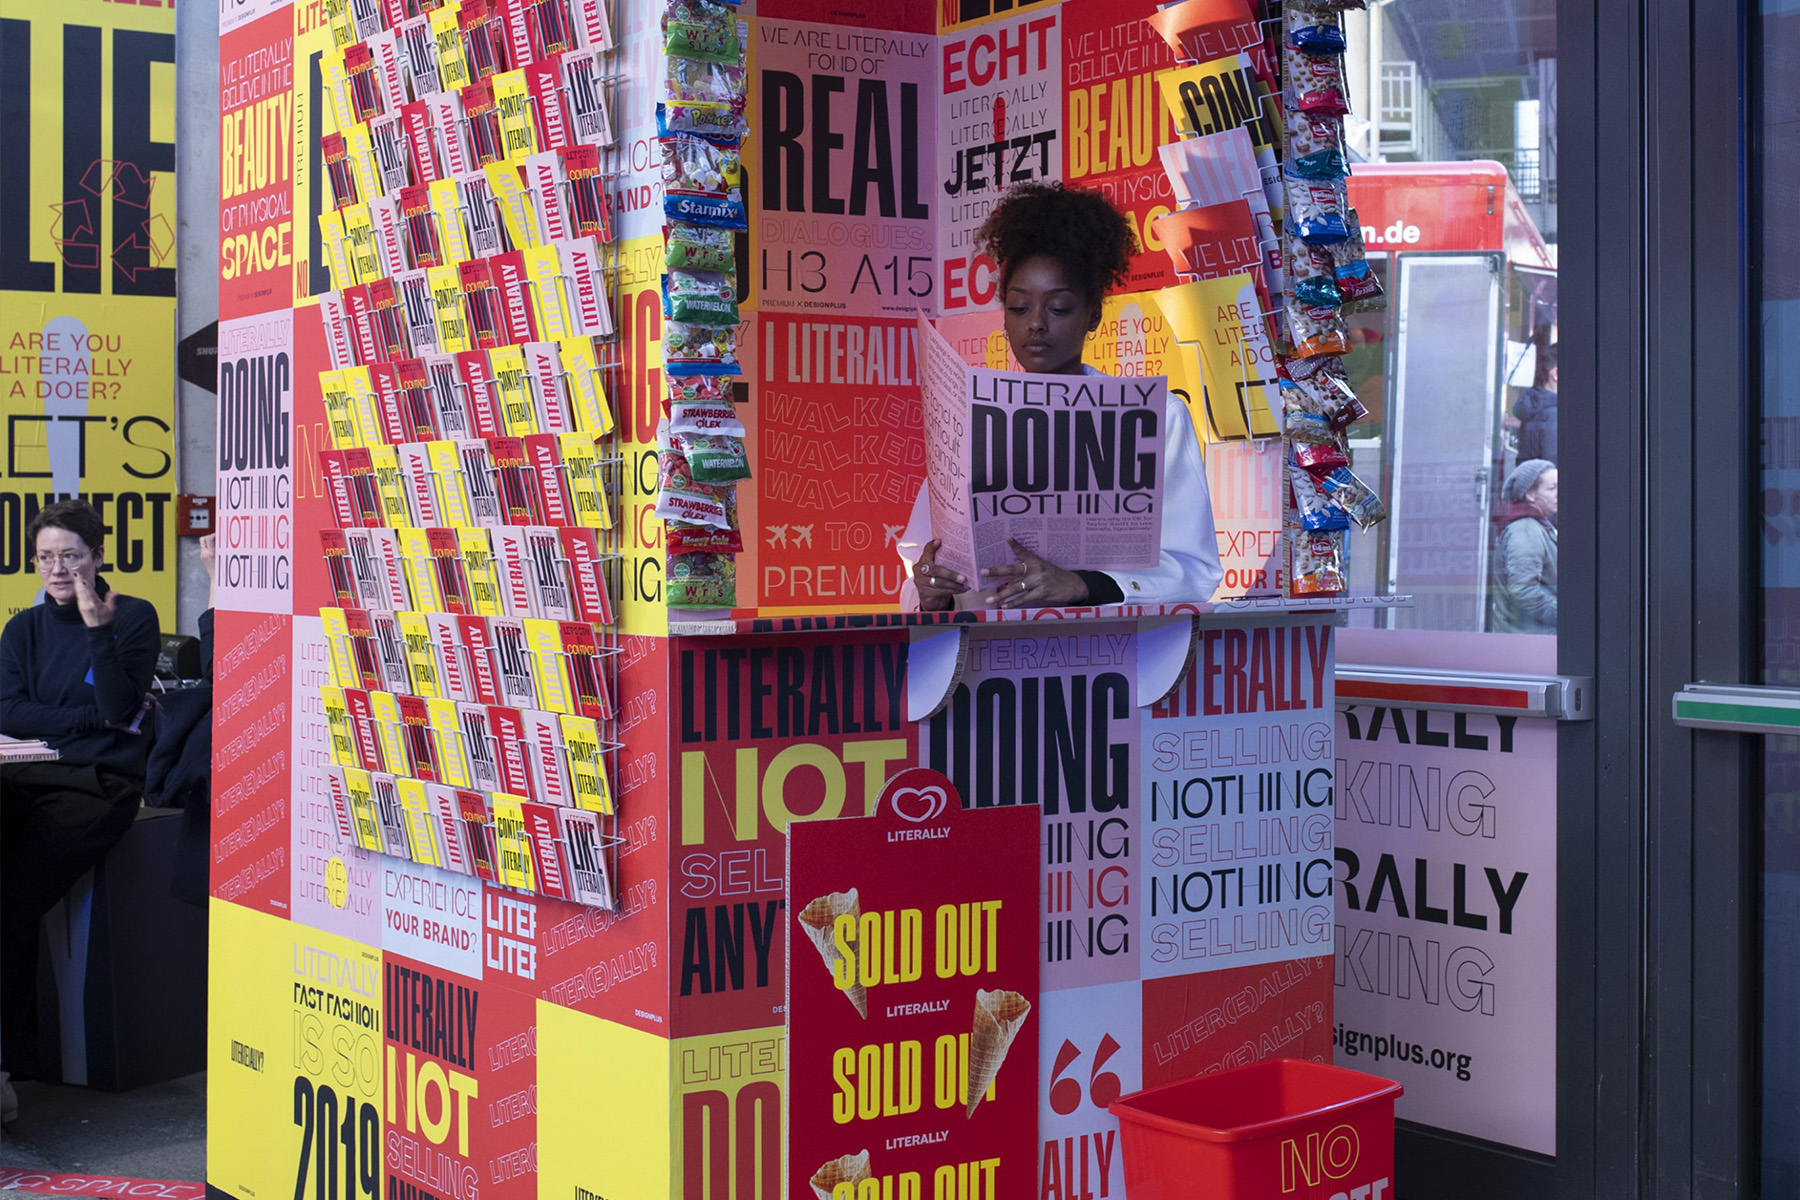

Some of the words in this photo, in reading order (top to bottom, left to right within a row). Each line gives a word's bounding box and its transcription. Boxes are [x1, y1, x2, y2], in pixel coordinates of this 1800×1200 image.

[239, 36, 292, 79] LITERALLY
[761, 26, 789, 45] WE
[794, 30, 832, 49] ARE
[836, 34, 929, 58] LITERALLY
[808, 53, 857, 73] FOND
[860, 57, 885, 75] OF
[943, 14, 1056, 95] ECHT
[1068, 32, 1094, 59] WE
[1068, 48, 1138, 86] BELIEVE
[222, 75, 261, 111] BELIEVE
[272, 62, 292, 90] THE
[380, 42, 402, 113] LITERALLY
[951, 81, 1048, 120] LITER(E)ALLY
[538, 72, 566, 149] LITERALLY
[951, 108, 1048, 146] LITER(E)ALLY
[222, 90, 293, 200] BEAUTY
[296, 92, 304, 186] PREMIUM
[762, 69, 929, 220] REAL
[943, 129, 1057, 196] JETZT
[222, 207, 237, 232] OF
[238, 192, 291, 225] PHYSICAL
[537, 164, 564, 241] LITERALLY
[680, 199, 735, 219] Starmix
[222, 221, 292, 280] SPACE
[762, 218, 933, 251] DIALOGUES.
[572, 250, 599, 328] LITERALLY
[762, 249, 827, 294] H3
[850, 254, 933, 298] A15
[1131, 271, 1165, 282] DESIGNPLUS
[686, 299, 731, 313] WATERMELON
[762, 299, 795, 308] PREMIUM
[804, 301, 847, 310] DESIGNPLUS
[1099, 320, 1128, 338] ARE
[1134, 316, 1163, 335] YOU
[1217, 302, 1252, 323] ARE
[9, 332, 61, 351] ARE
[70, 333, 122, 353] YOU
[220, 318, 290, 357] LITERALLY
[766, 321, 775, 381] I
[1093, 337, 1170, 360] LITERALLY
[1230, 352, 1242, 367] A
[0, 355, 133, 377] LITERALLY
[9, 380, 26, 398] A
[36, 381, 122, 400] DOER?
[536, 353, 562, 429] LITERALLY
[973, 375, 1158, 407] LITERALLY
[1113, 360, 1162, 377] DOER?
[220, 351, 290, 471] DOING
[764, 390, 925, 433] WALKED
[0, 414, 171, 479] ET'S
[702, 458, 744, 469] WATERMELON
[764, 429, 926, 472] WALKED
[972, 403, 1158, 494] DOING
[218, 474, 290, 510] NOTHING
[536, 444, 563, 520] LITERALLY
[668, 497, 723, 517] STRAWBERRIES
[764, 468, 923, 510] WALKED
[973, 493, 1154, 523] NOTHING
[218, 514, 290, 549] NOTHING
[825, 522, 872, 551] TO
[217, 554, 290, 590] NOTHING
[503, 536, 529, 610] LITERALLY
[573, 538, 601, 615] LITERALLY
[439, 623, 463, 693] LITERALLY
[1151, 625, 1332, 719] TERALLY
[216, 654, 287, 727] LITER(E)ALLY?
[681, 640, 909, 744] LITERALLY
[215, 702, 286, 772] LITER(E)ALLY?
[500, 716, 525, 791] LITERALLY
[537, 722, 562, 798] LITERALLY
[929, 672, 1130, 816] DOING
[1152, 722, 1332, 773] SELLING
[214, 750, 286, 818] LITER(E)ALLY?
[681, 738, 908, 846] NOT
[1151, 768, 1333, 822] NOTHING
[213, 798, 285, 864] LITER(E)ALLY?
[534, 814, 561, 890] LITERALLY
[887, 826, 951, 843] LITERALLY
[1152, 814, 1332, 868] SELLING
[300, 853, 373, 890] LITER(E)ALLY
[300, 880, 373, 916] LITER(E)ALLY
[385, 869, 478, 920] EXPERIENCE
[1151, 858, 1333, 917] NOTHING
[385, 907, 420, 935] YOUR
[423, 919, 478, 954] BRAND?
[542, 878, 657, 958] LITER(E)ALLY?
[832, 908, 922, 991] SOLD
[935, 899, 1002, 979] OUT
[1151, 905, 1331, 963] SELLING
[293, 942, 379, 998] LITERALLY
[679, 899, 786, 997] ANY
[293, 982, 325, 1010] FAST
[326, 992, 379, 1033] FASHION
[386, 961, 478, 1072] LITERALLY
[886, 999, 950, 1018] LITERALLY
[1153, 954, 1325, 1067] LITER(E)ALLY?
[293, 1009, 325, 1076] IS
[331, 1024, 380, 1098] SO
[386, 1044, 479, 1158] NOT
[832, 1039, 922, 1125] SOLD
[293, 1075, 380, 1200] 2019
[387, 1129, 479, 1200] SELLING
[885, 1130, 950, 1150] LITERALLY
[1281, 1124, 1360, 1194] NO
[51, 1178, 196, 1199] SPACE
